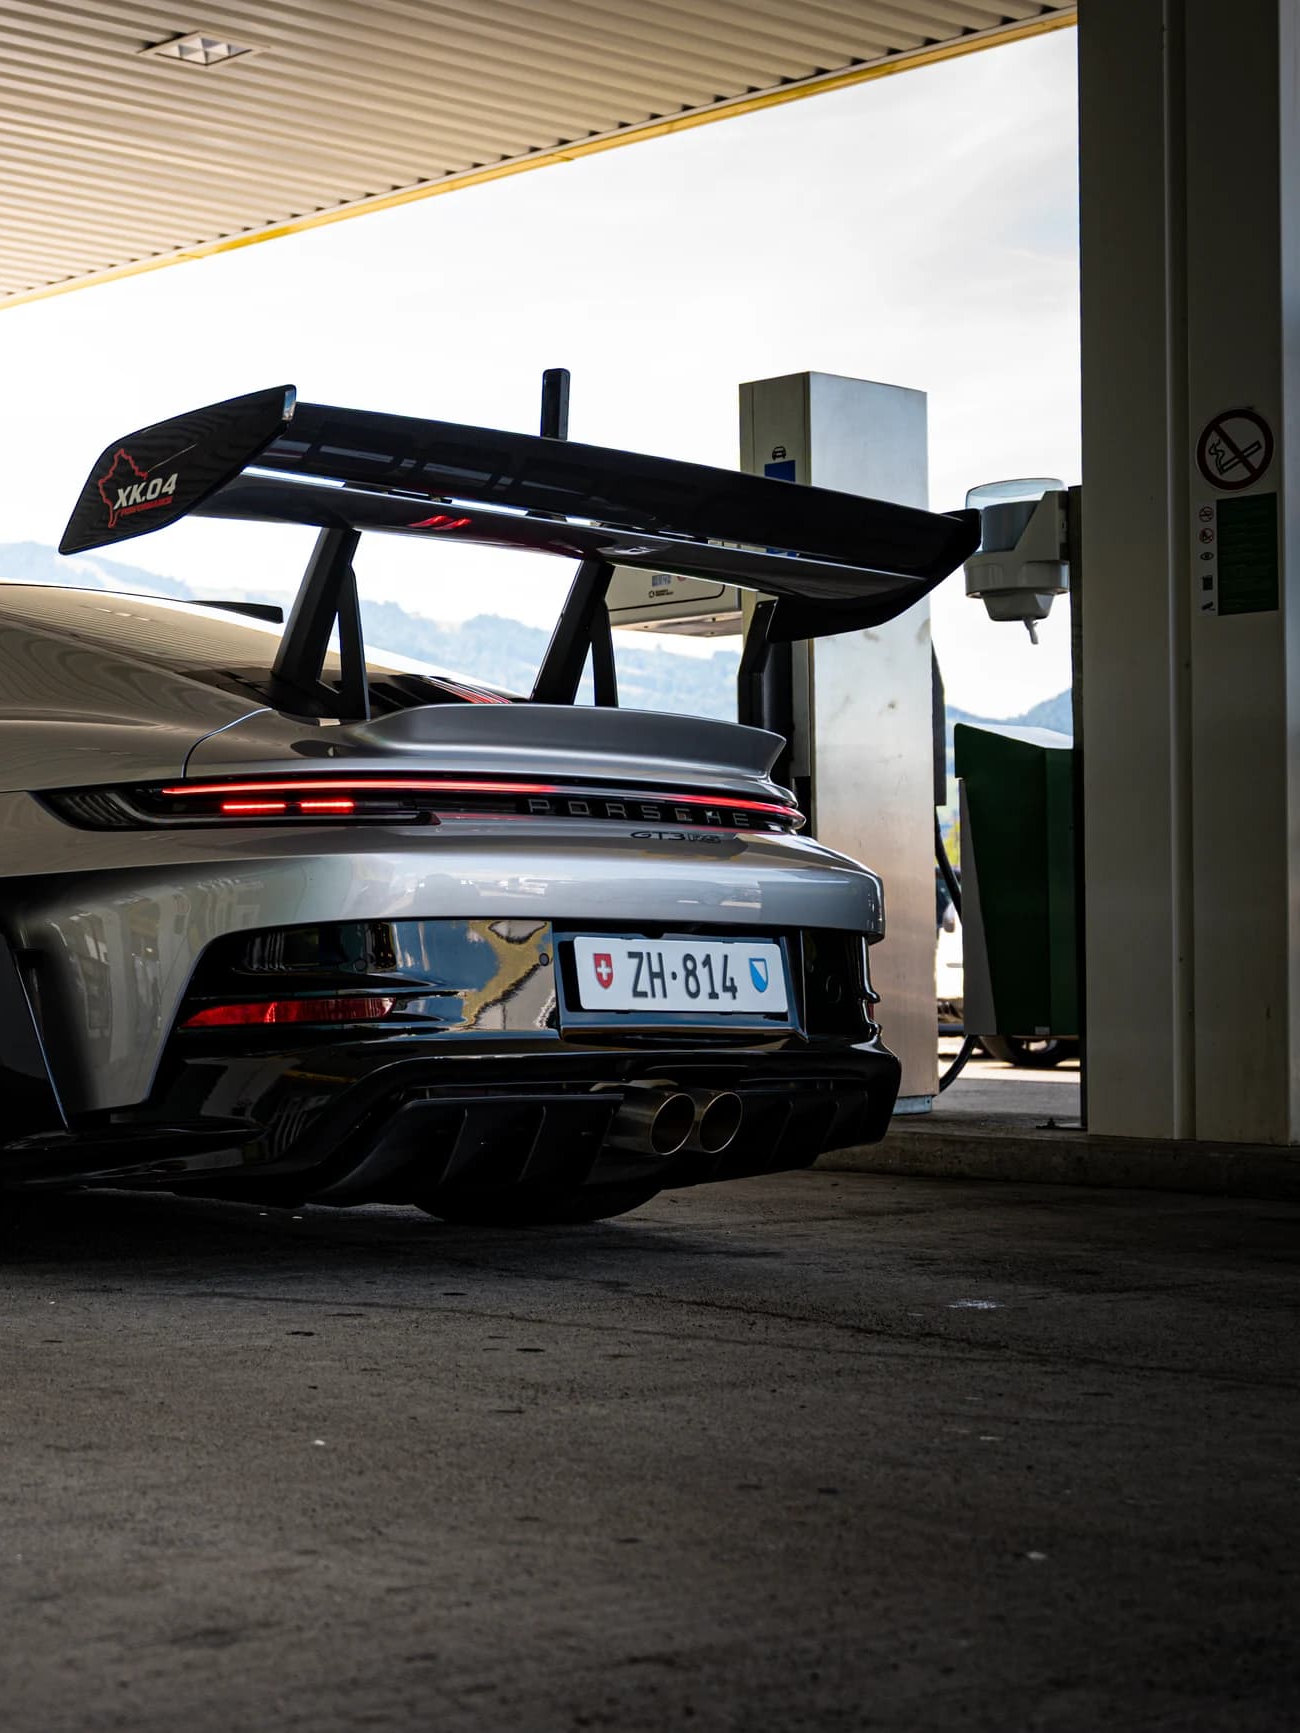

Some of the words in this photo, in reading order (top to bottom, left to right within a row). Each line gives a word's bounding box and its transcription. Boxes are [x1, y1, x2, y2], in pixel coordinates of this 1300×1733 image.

[113, 473, 178, 510] XK.04
[528, 799, 750, 827] PORSCHE
[627, 951, 738, 1000] ZH·814
